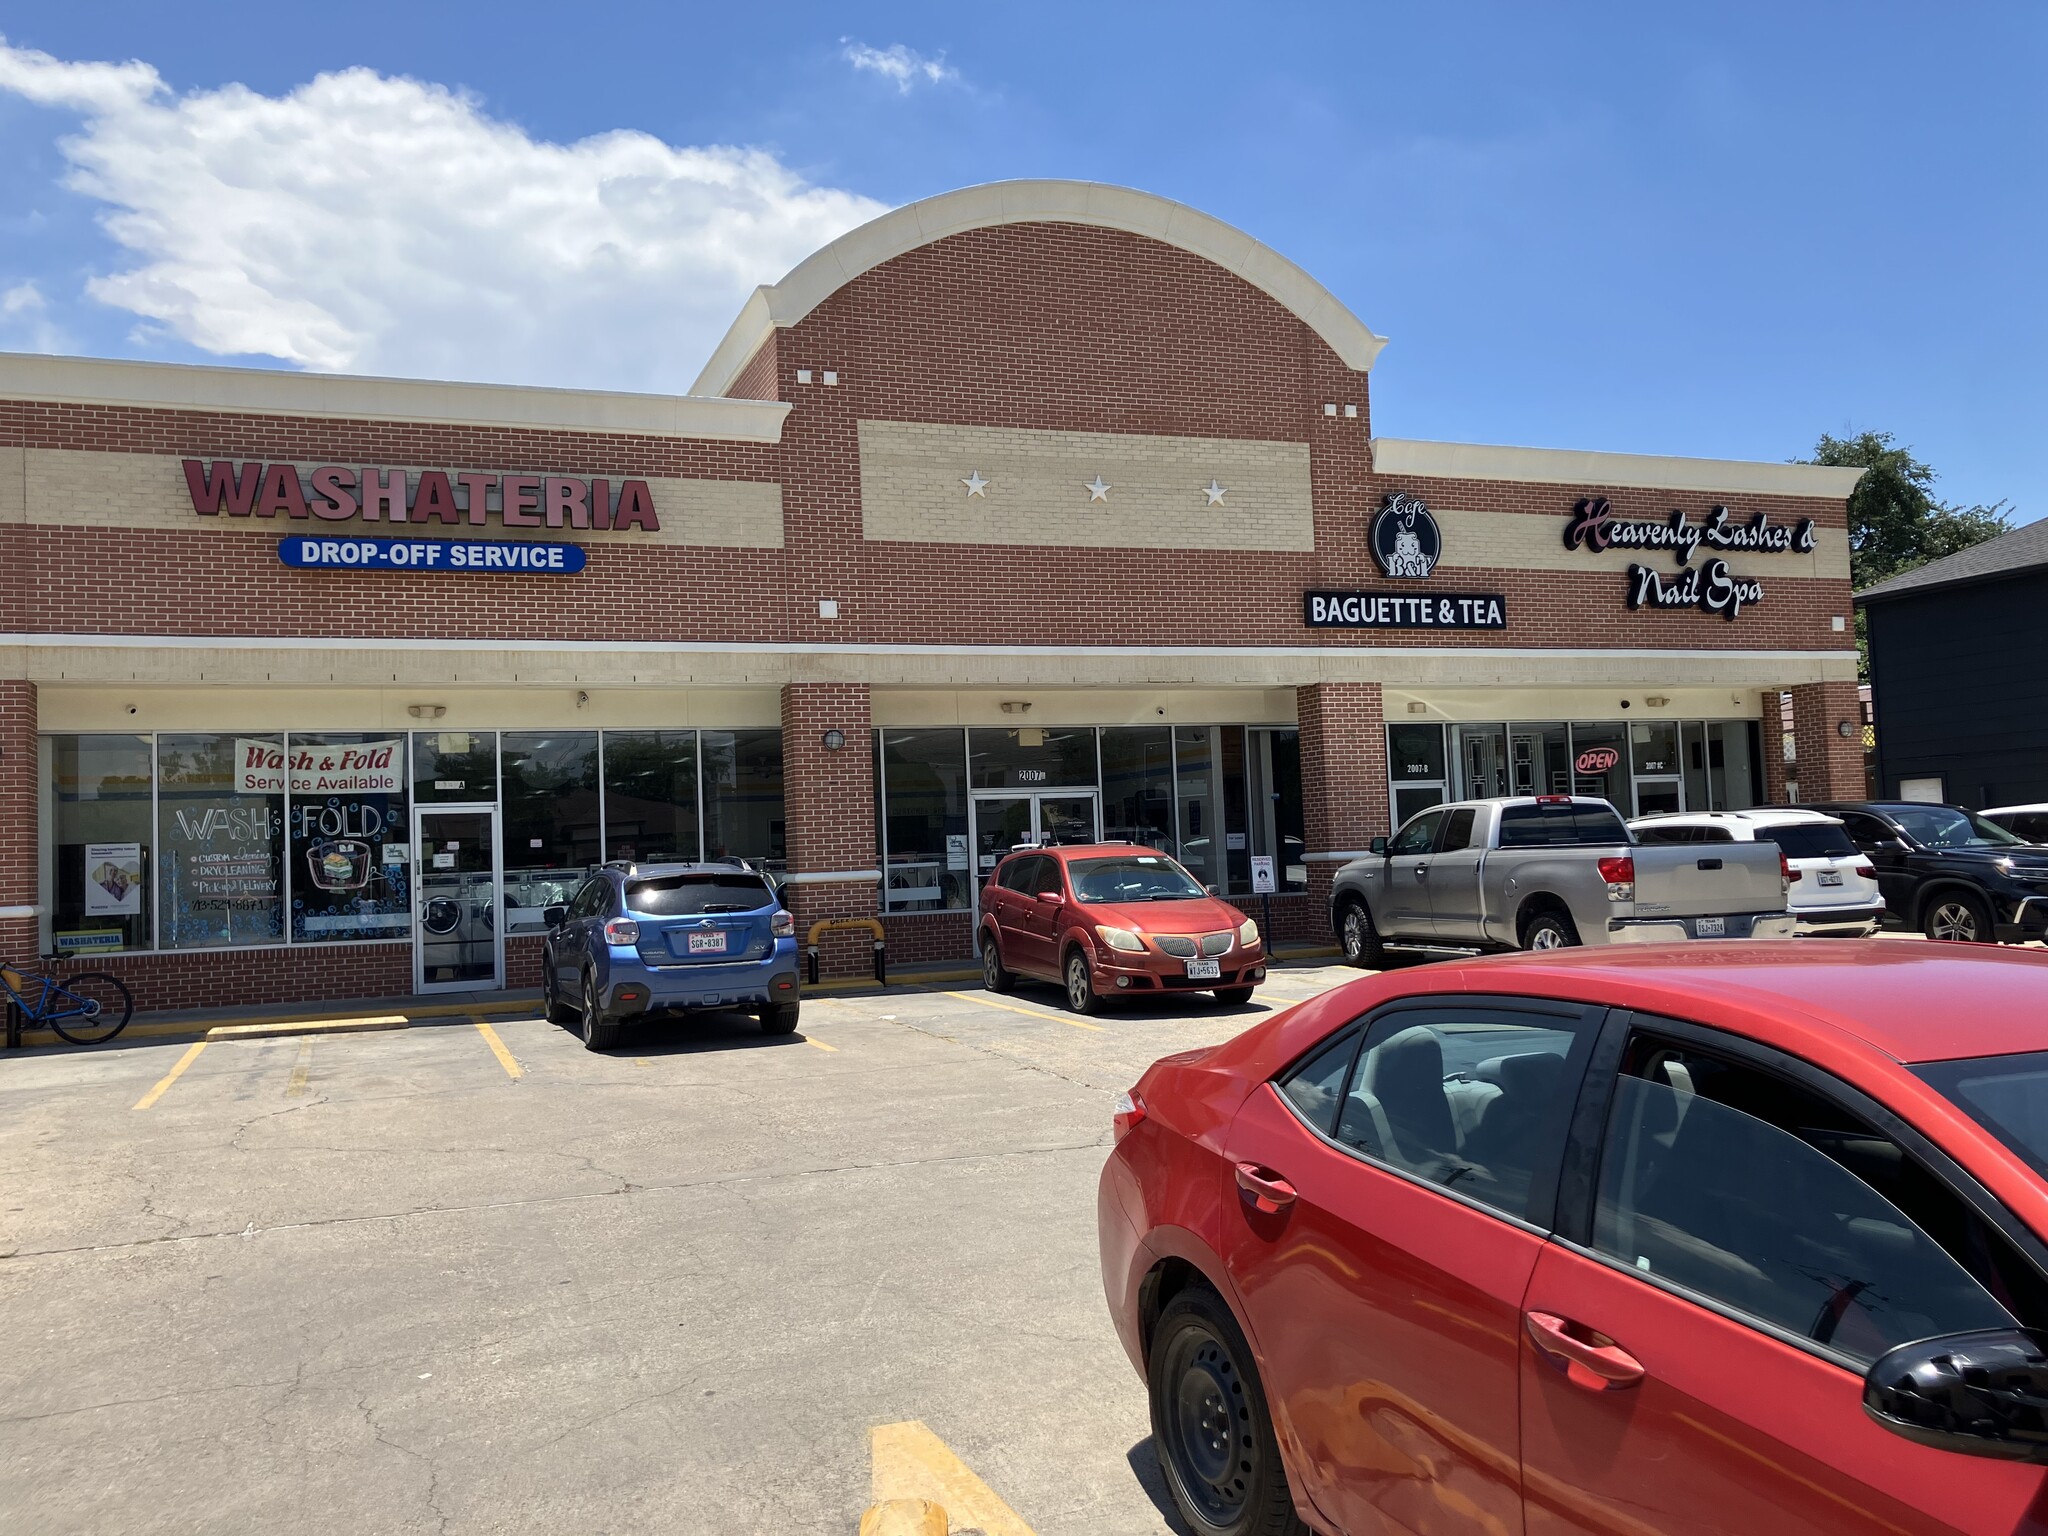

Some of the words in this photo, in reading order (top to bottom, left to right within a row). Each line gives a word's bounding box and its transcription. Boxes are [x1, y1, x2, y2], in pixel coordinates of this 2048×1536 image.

[181, 459, 660, 532] WASHATERIA
[1388, 493, 1427, 528] Cafe
[1573, 500, 1702, 561] Heavenly
[1707, 506, 1792, 548] Lashes
[1800, 519, 1819, 549] &
[302, 541, 442, 566] DROP-OFF
[450, 545, 564, 568] SERVICE
[1636, 566, 1701, 605] Nail
[1706, 560, 1766, 618] Spa
[1312, 597, 1433, 624] BAGUETTE
[1438, 599, 1456, 624] &
[1458, 600, 1502, 625] TEA
[245, 747, 314, 770] Wash
[319, 756, 335, 771] &
[339, 747, 393, 771] Fold
[1579, 753, 1614, 769] OPEN
[245, 775, 312, 790] Servce
[316, 776, 394, 790] Available
[1019, 770, 1041, 781] 2007
[176, 808, 271, 842] WASH
[302, 805, 382, 838] FOLD
[199, 853, 230, 863] CUSTOM
[60, 935, 120, 946] WASHATERIA
[691, 938, 724, 949] SGR-8387
